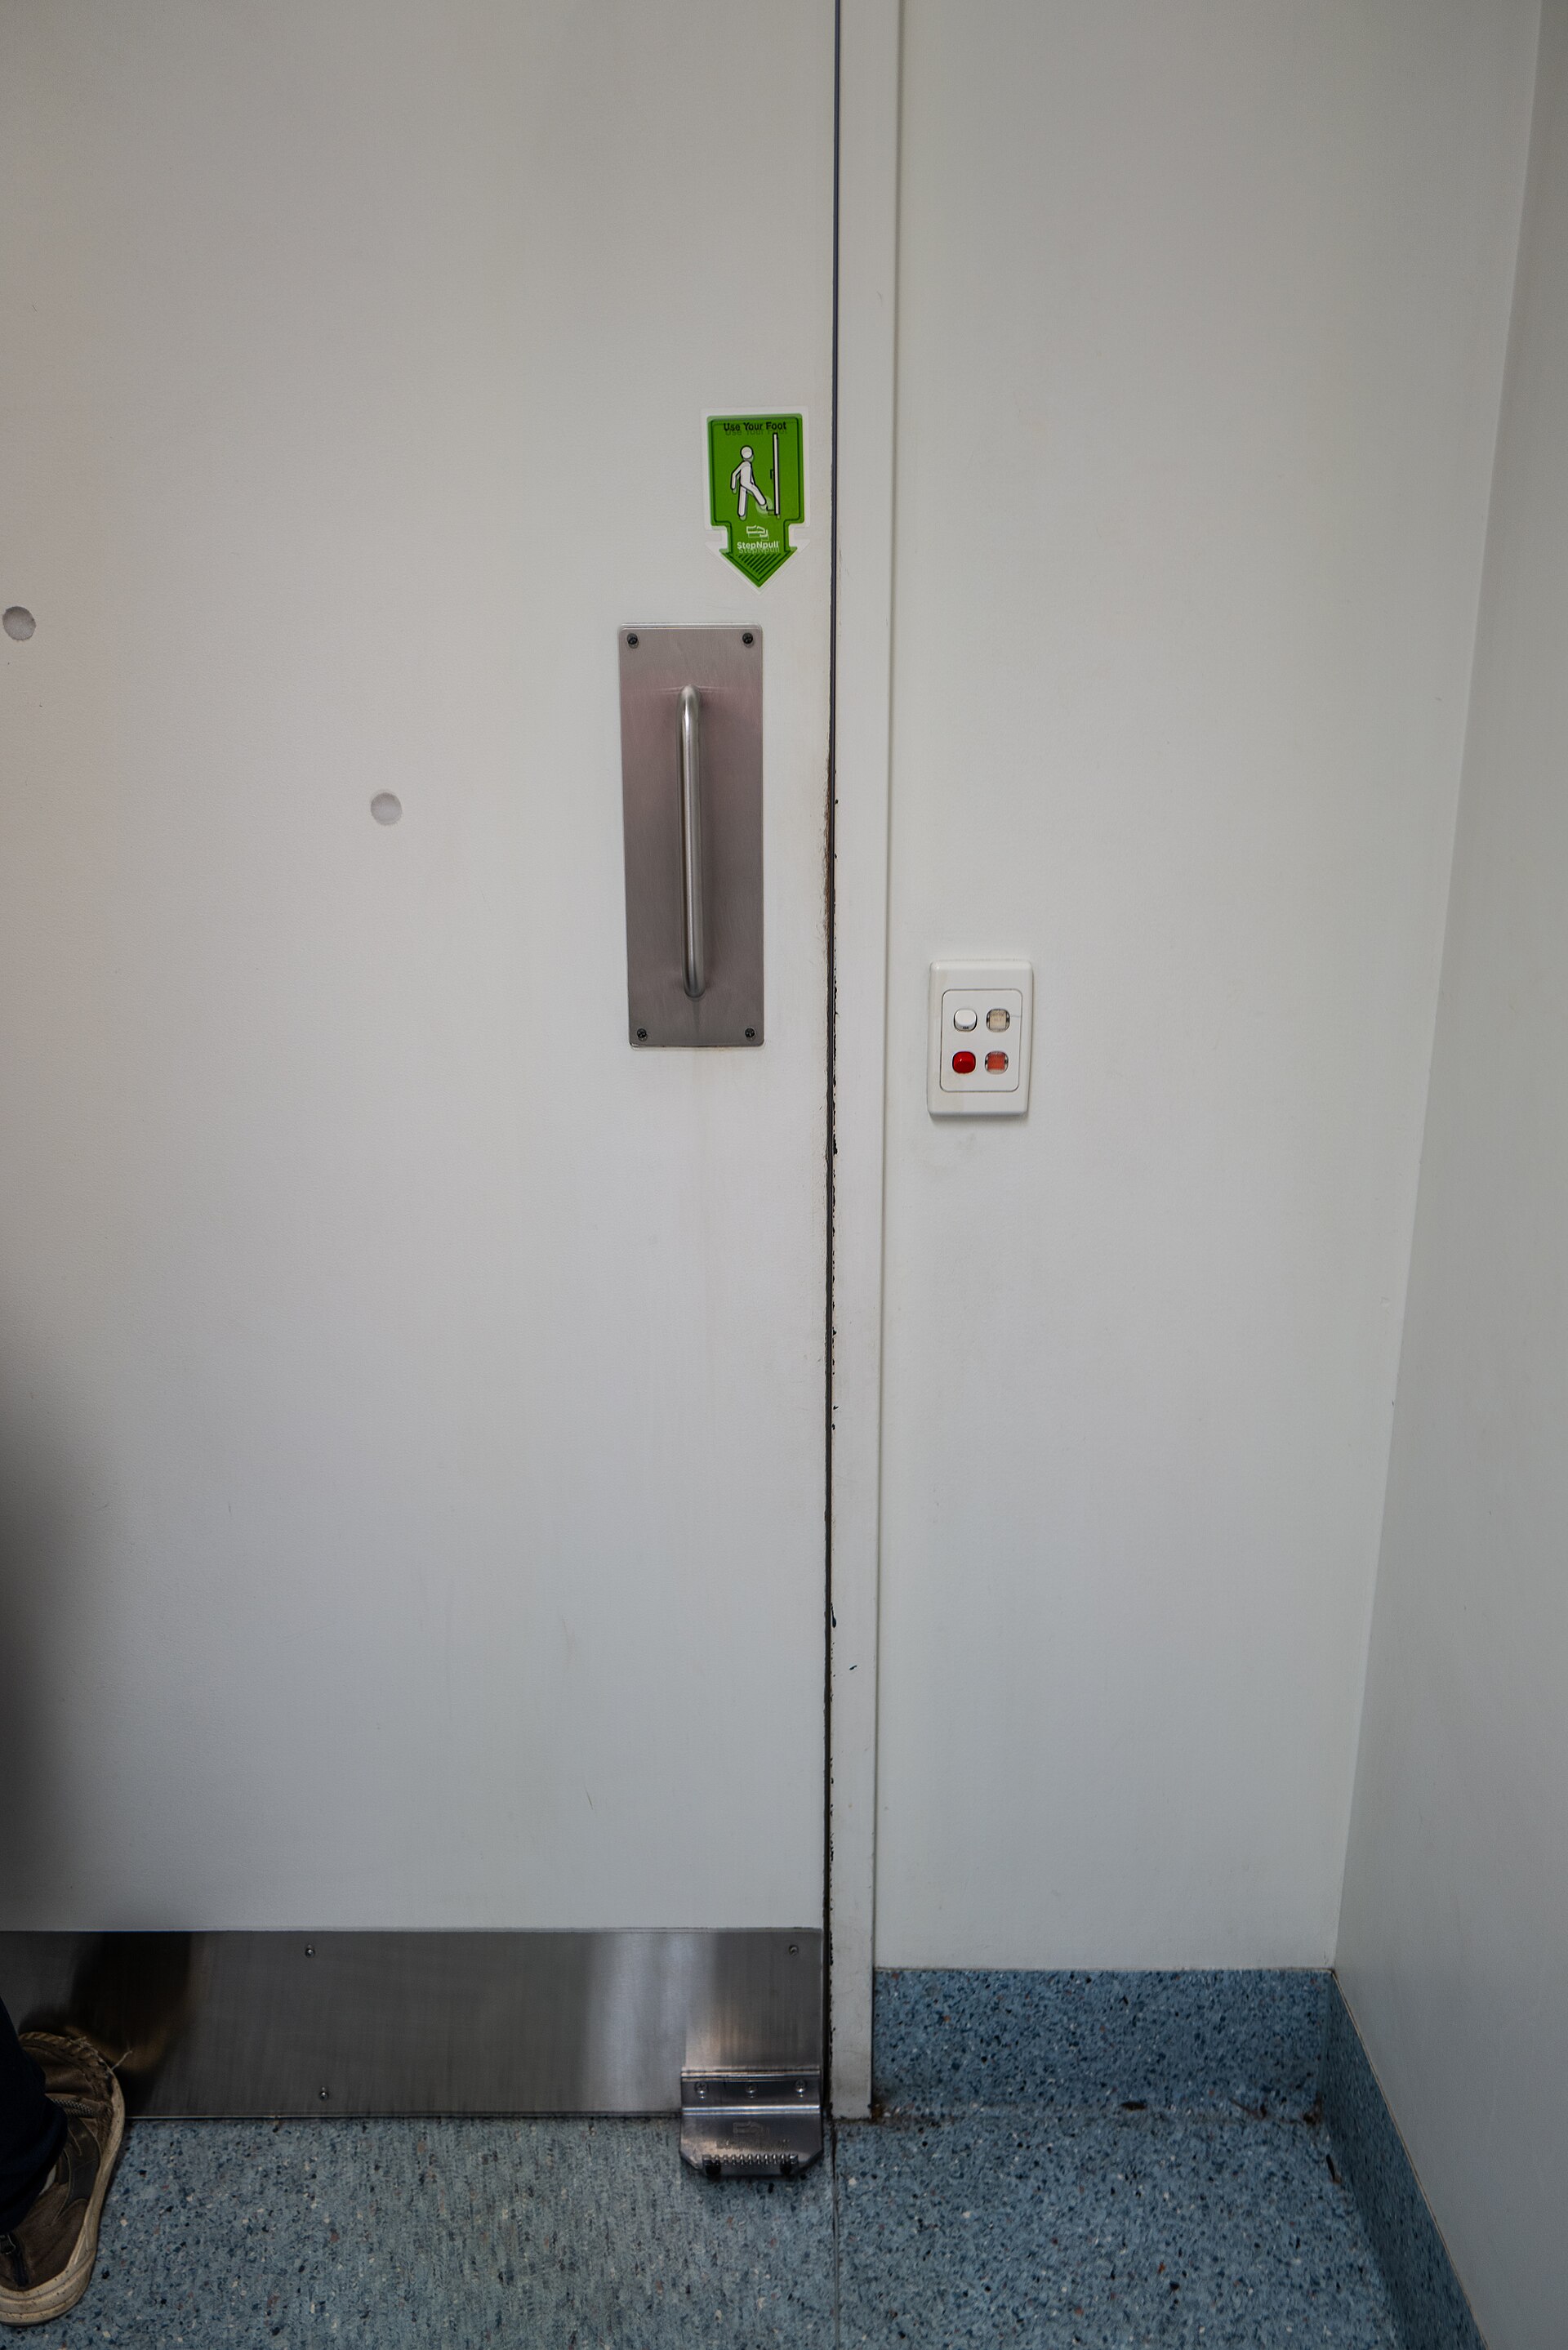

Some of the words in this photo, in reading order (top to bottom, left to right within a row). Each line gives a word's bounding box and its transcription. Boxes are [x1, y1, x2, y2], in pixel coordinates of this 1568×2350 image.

[723, 422, 741, 431] Use
[743, 421, 763, 430] Your
[766, 421, 786, 430] Foot
[737, 541, 778, 550] StepNpull
